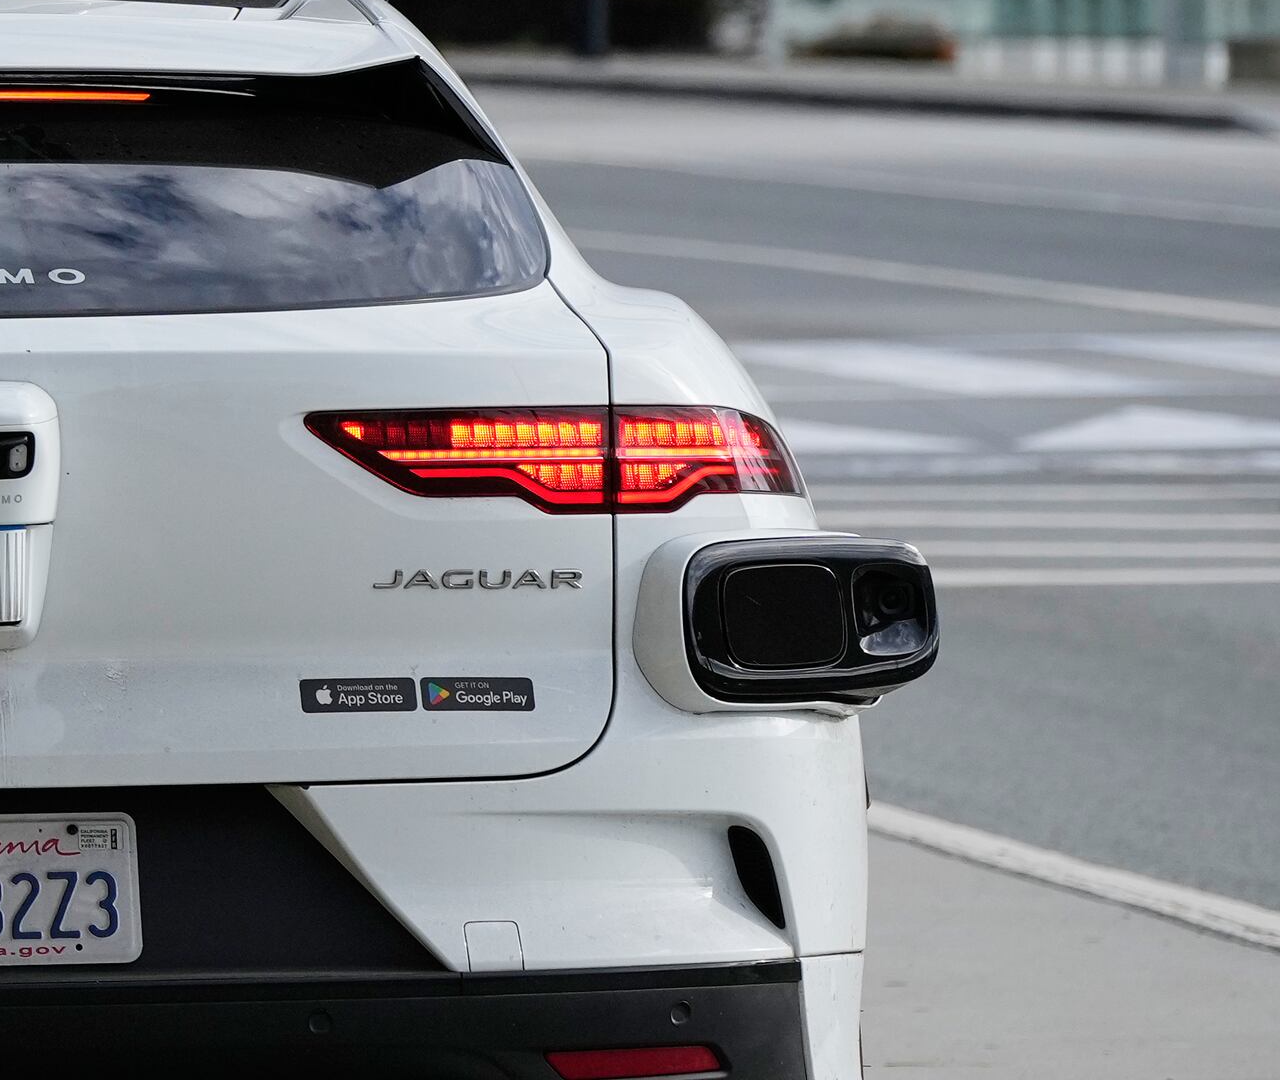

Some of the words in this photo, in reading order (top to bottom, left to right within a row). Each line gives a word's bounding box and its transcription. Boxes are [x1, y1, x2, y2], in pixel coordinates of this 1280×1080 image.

[372, 568, 584, 590] JAGUAR
[454, 681, 469, 689] GET
[477, 681, 490, 689] ON
[338, 692, 365, 707] App
[367, 692, 404, 705] Store
[455, 690, 501, 707] Google
[502, 690, 528, 707] Play
